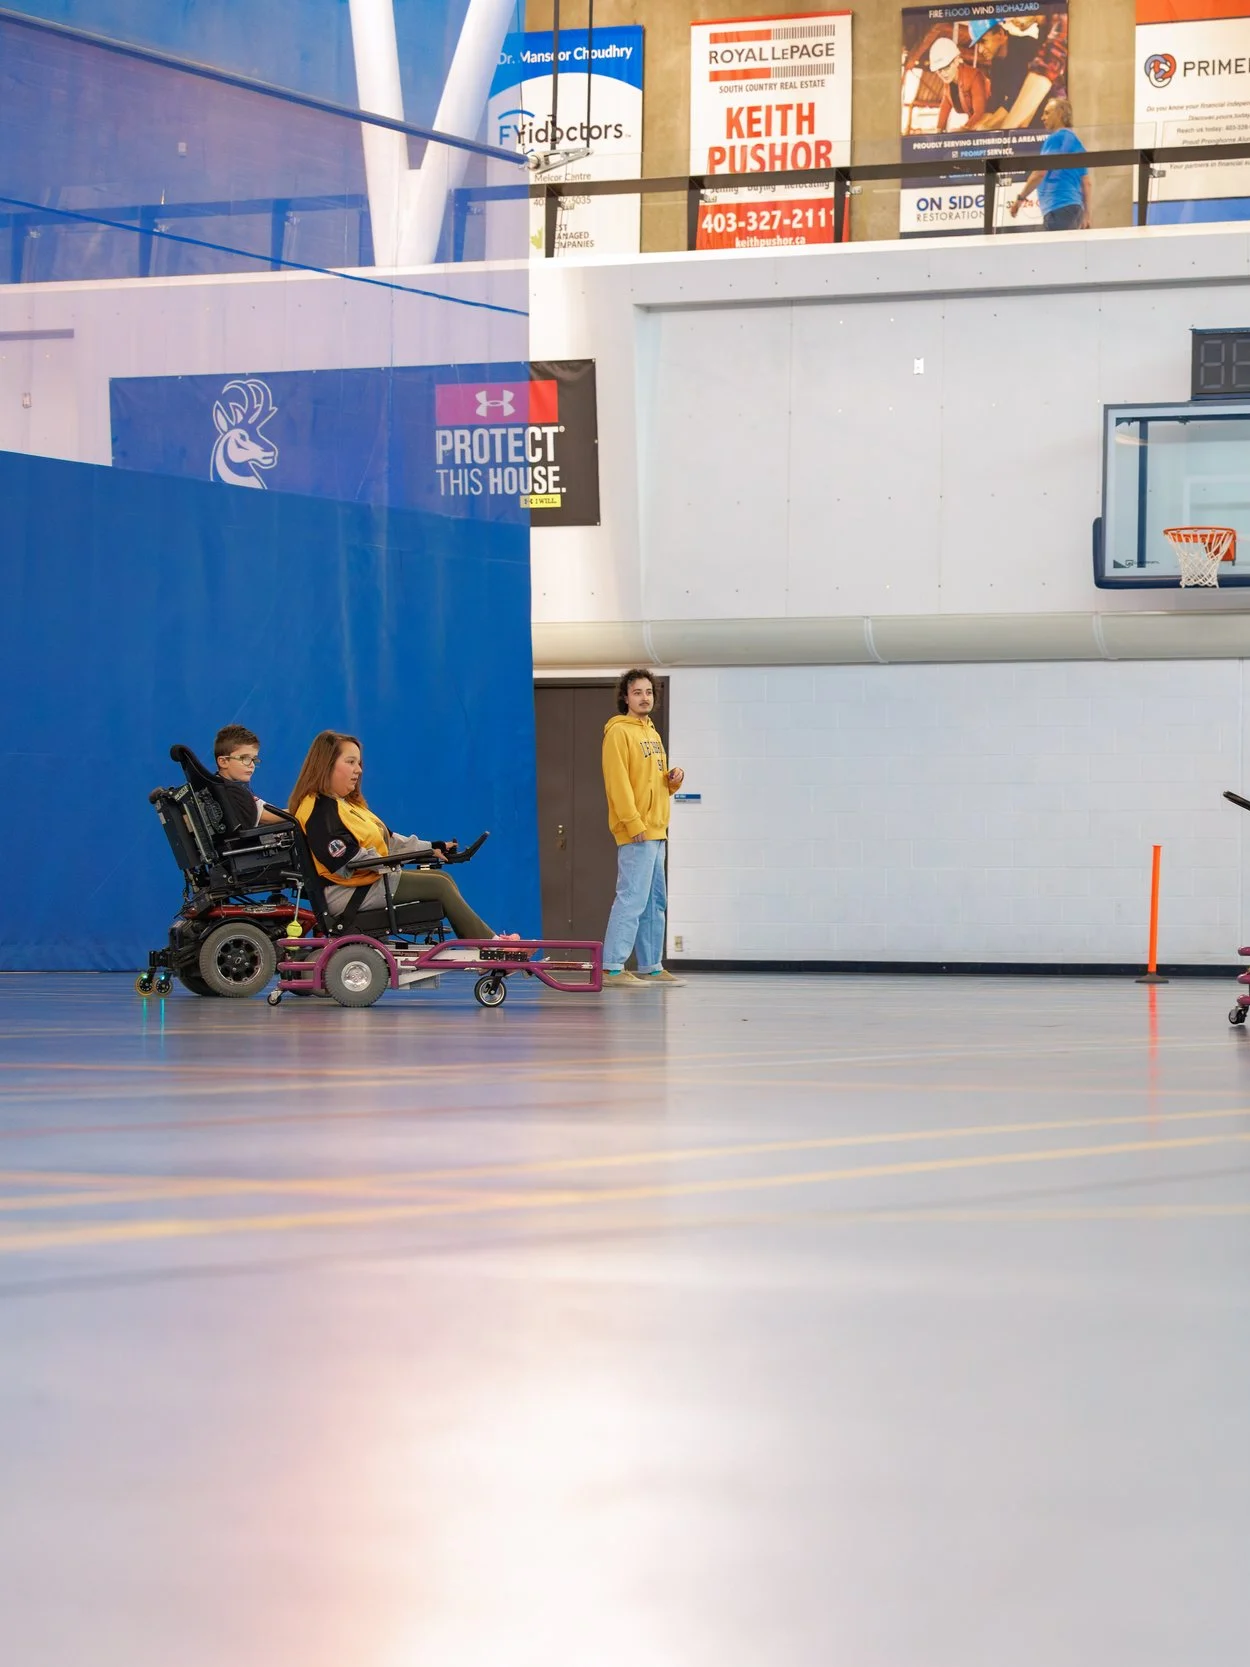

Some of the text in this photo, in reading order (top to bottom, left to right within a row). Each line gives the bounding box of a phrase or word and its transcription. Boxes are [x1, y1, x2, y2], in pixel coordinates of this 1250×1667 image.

[929, 2, 1039, 18] FIRE FLOOD WIND BIOHAZARD
[708, 47, 769, 65] ROYAL
[719, 78, 826, 94] SOUTH COUNTRY REAL ESTATE
[1185, 103, 1200, 111] your
[1200, 101, 1226, 109] financial
[726, 102, 815, 139] KEITH
[913, 141, 942, 150] PROUDLY
[943, 139, 972, 148] SERVING
[972, 137, 1011, 147] LETHBRIDGE
[1018, 135, 1036, 143] AREA
[708, 140, 833, 176] PUSHOR
[916, 197, 942, 211] ON
[916, 210, 985, 223] RESTORATION
[556, 231, 590, 240] ANAGED
[735, 234, 807, 248] keithpushor.ca
[554, 240, 595, 249] OMPANIES
[436, 426, 558, 464] PROTECT
[435, 466, 567, 496] THIS HOUSE.
